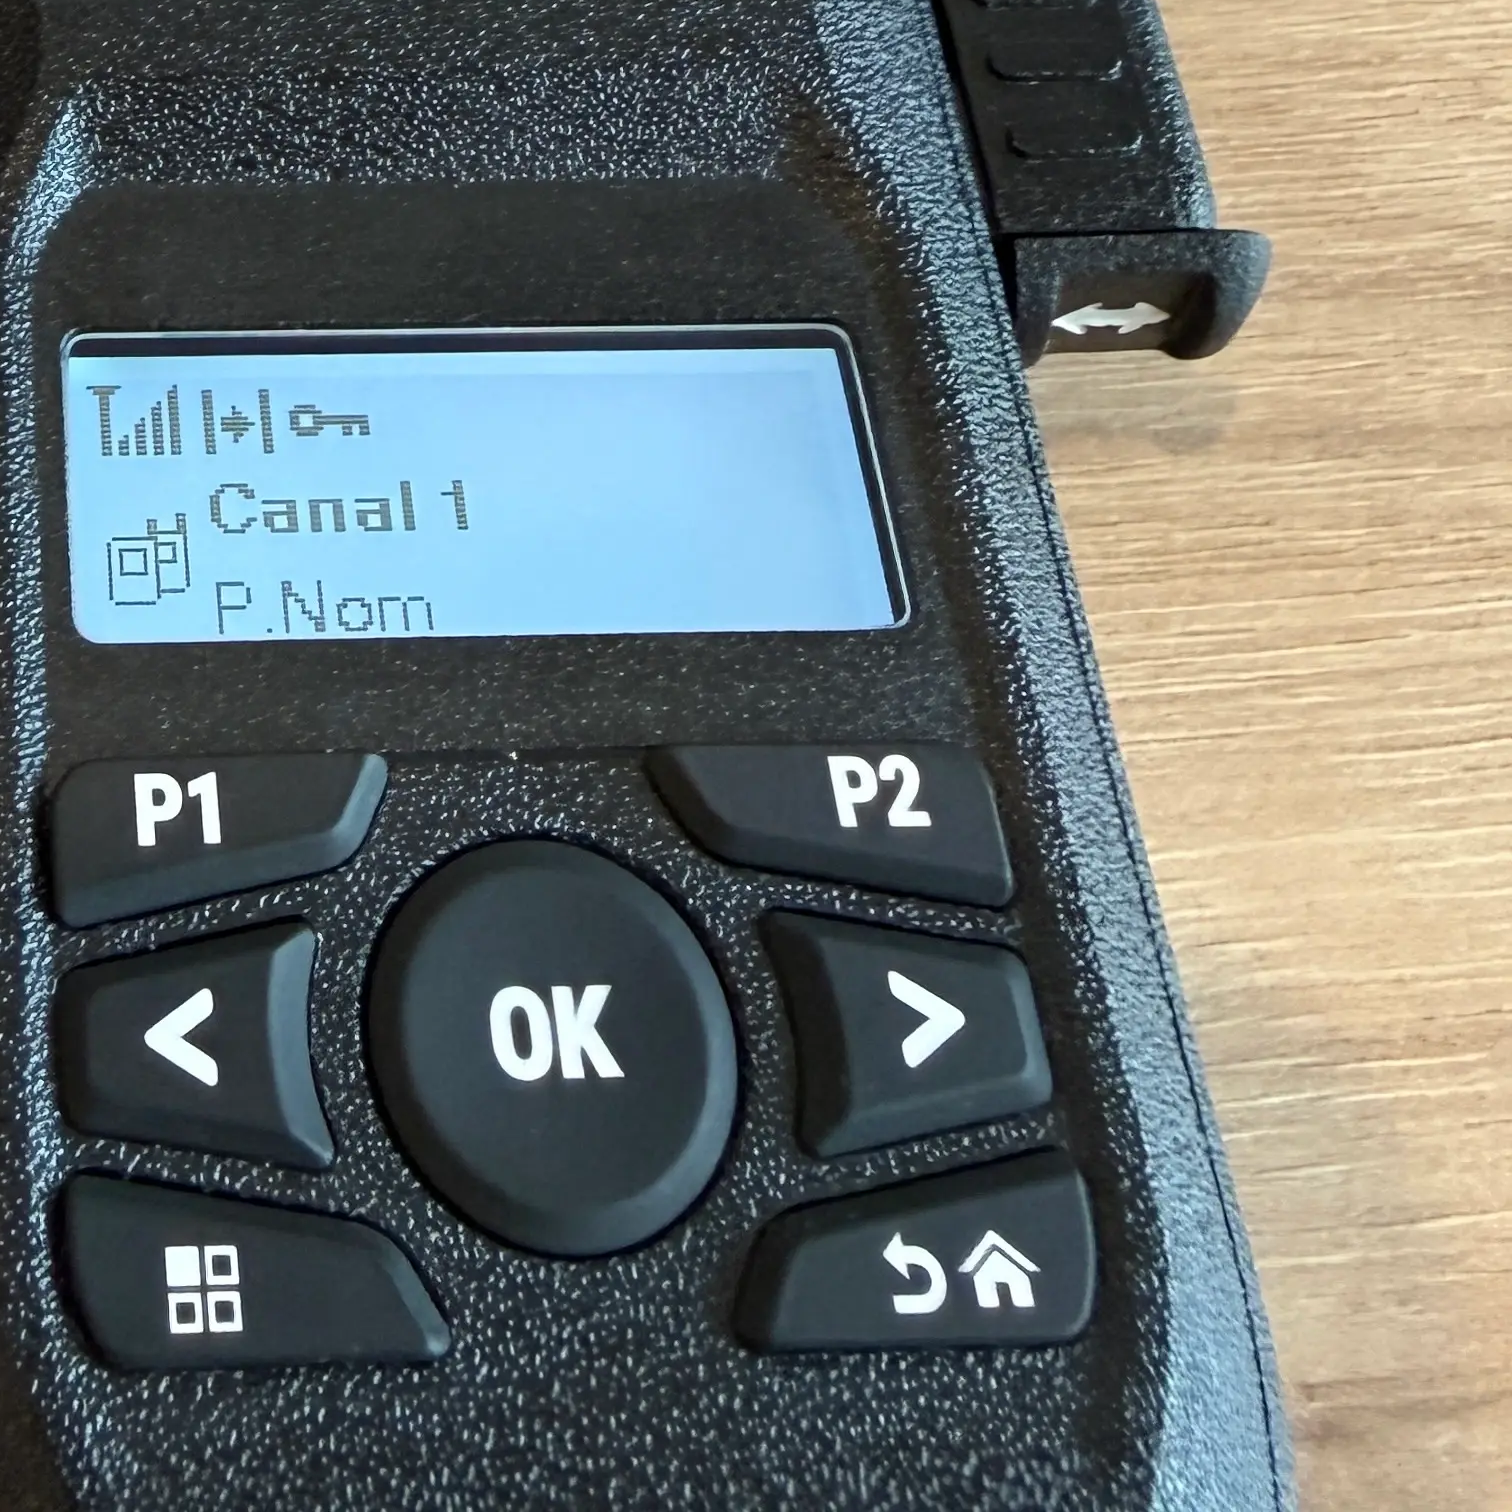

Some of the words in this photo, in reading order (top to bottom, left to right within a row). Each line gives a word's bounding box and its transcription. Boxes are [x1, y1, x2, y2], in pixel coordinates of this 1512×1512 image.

[209, 480, 417, 535] Canal
[440, 479, 469, 531] 1
[214, 579, 436, 635] P.Nom
[132, 770, 223, 848] P1
[825, 753, 933, 830] P2
[488, 983, 626, 1082] OK
